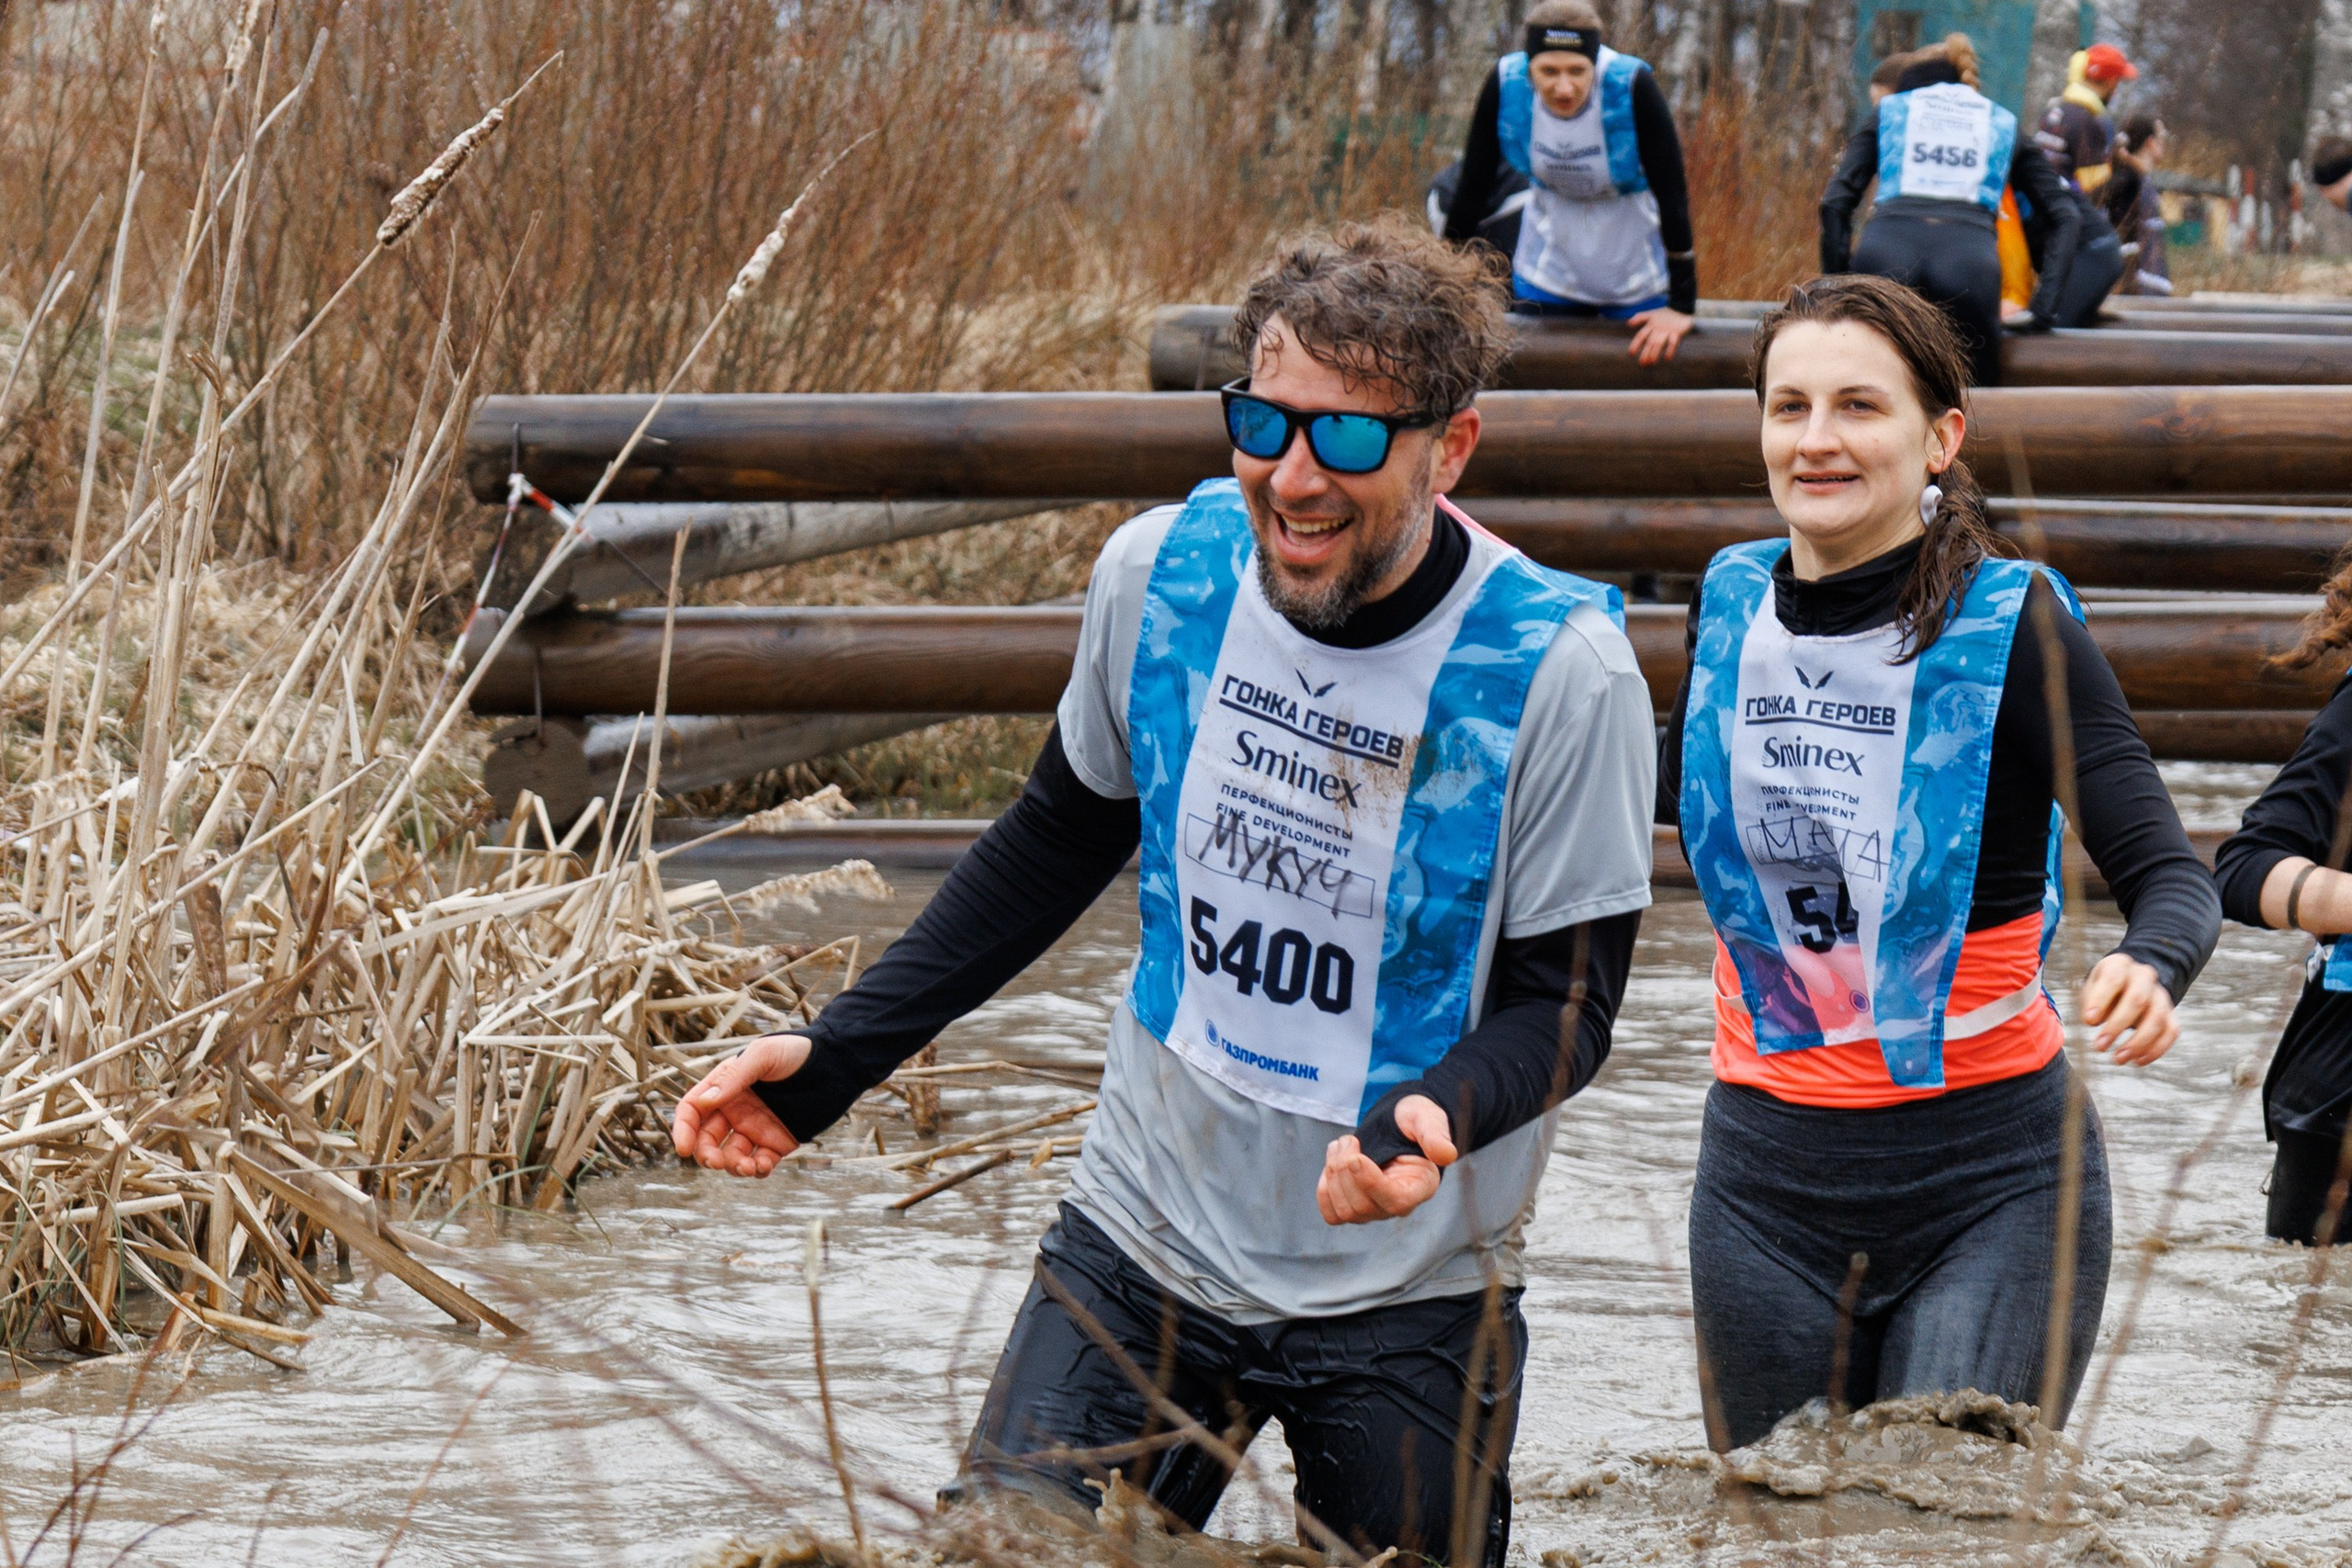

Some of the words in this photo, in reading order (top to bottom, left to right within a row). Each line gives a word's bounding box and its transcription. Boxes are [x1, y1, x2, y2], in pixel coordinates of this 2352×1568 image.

[1912, 142, 1978, 167] 5456
[1221, 674, 1297, 724] ГОНКА
[1304, 707, 1405, 760] ГЕРОЕВ
[1746, 695, 1796, 717] ГОНКА
[1805, 699, 1896, 727] ГЕРОЕВ
[1231, 729, 1362, 808] Sminex
[1761, 735, 1865, 776] Sminex
[1216, 802, 1248, 821] FINE
[1252, 815, 1351, 858] DEVELOPMENT
[1220, 784, 1353, 841] ПЕРФЕКЦИОНИСТЫ
[1190, 895, 1355, 1015] 5400
[1220, 1037, 1320, 1082] ГАЗПРОМБАНК
